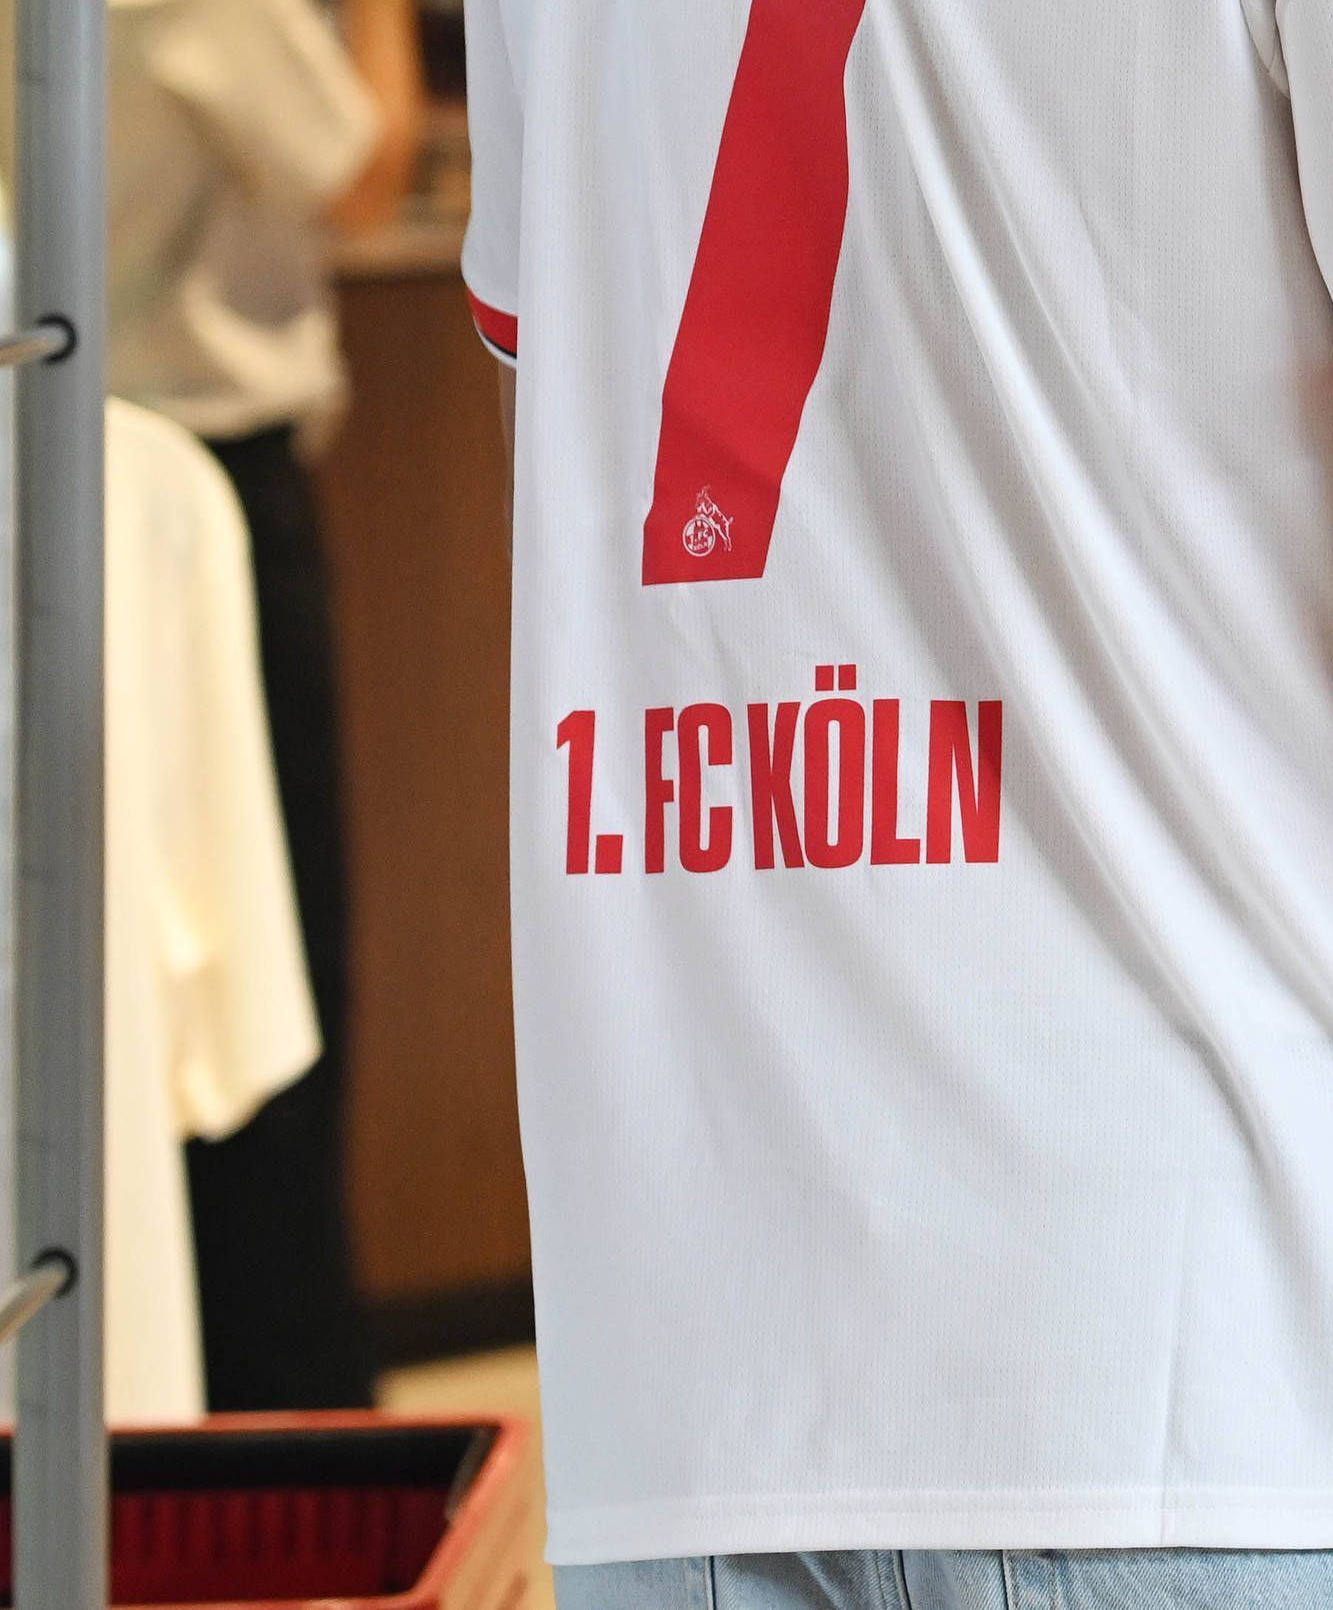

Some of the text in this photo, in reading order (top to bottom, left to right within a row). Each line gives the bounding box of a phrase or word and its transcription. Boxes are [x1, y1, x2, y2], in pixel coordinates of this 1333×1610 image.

[556, 664, 1003, 875] 1. FC KÖLN
